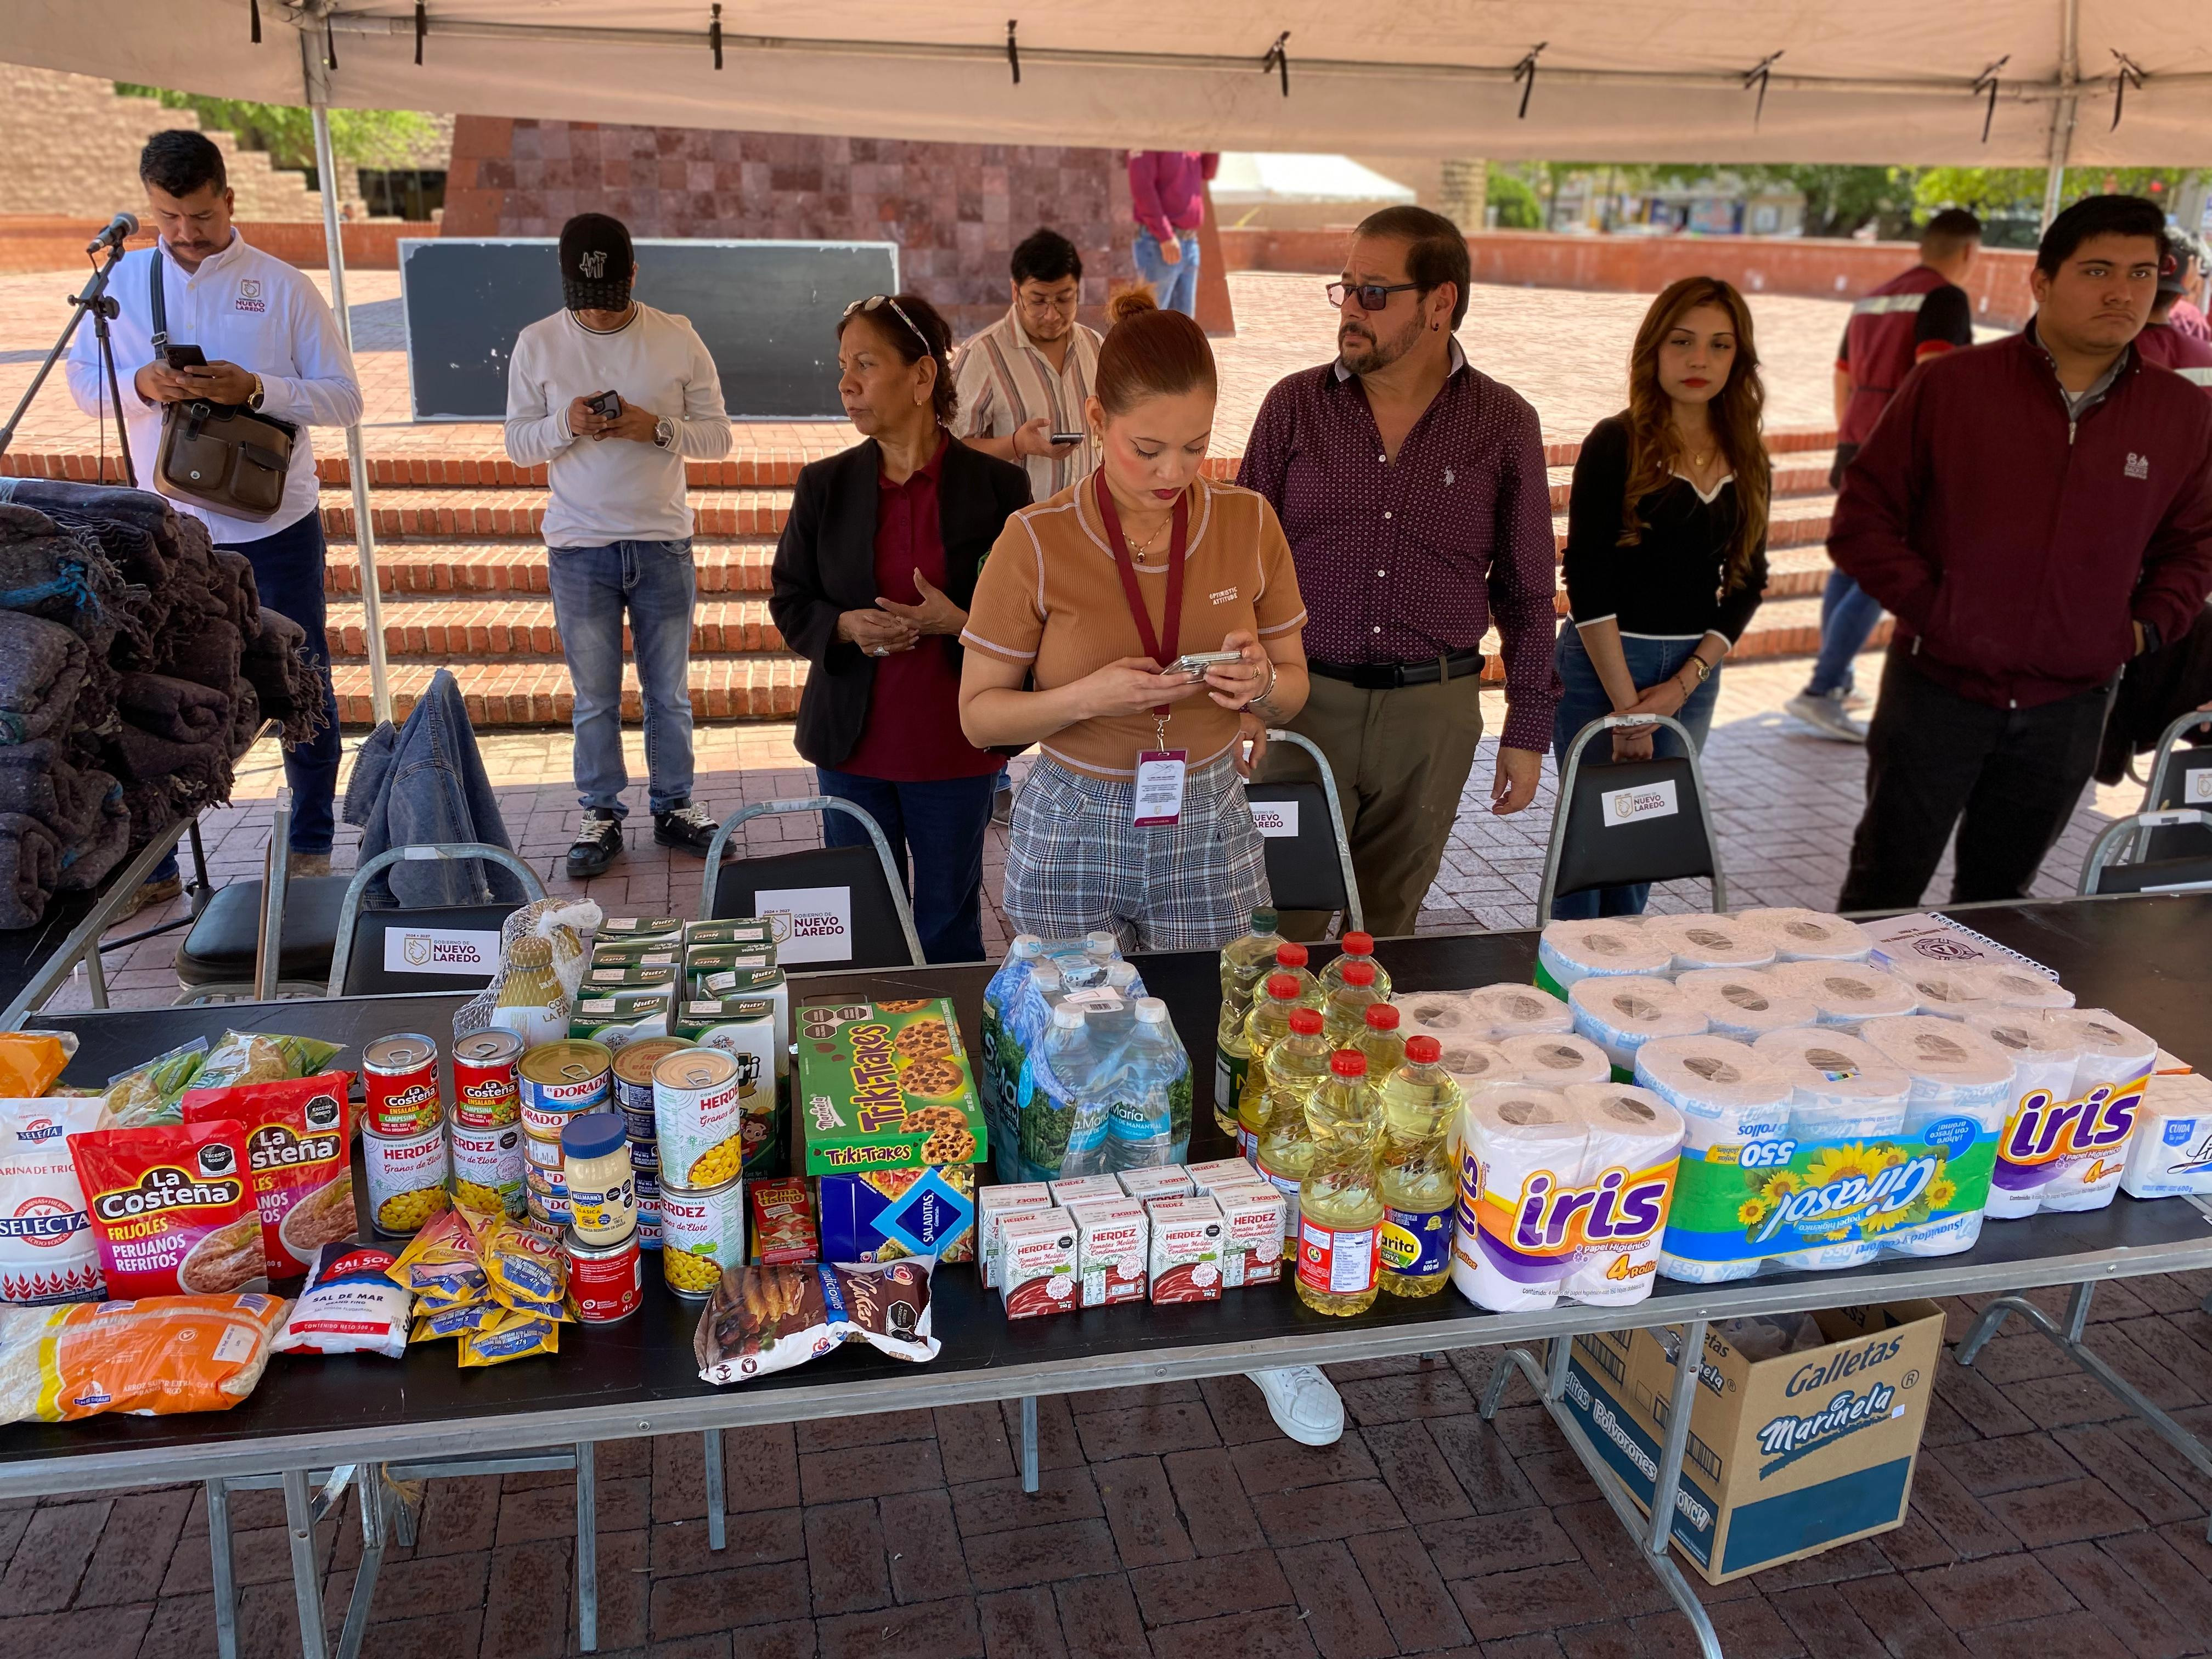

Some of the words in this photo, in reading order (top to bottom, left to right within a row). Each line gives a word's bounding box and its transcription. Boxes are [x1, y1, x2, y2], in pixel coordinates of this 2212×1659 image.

[1209, 586, 1238, 599] OPTIMISTIC
[1213, 593, 1238, 605] ATTITUDE
[1634, 795, 1661, 805] NUEVO
[1635, 801, 1664, 812] LAREDO
[794, 917, 839, 927] NUEVO
[794, 926, 844, 937] LAREDO
[434, 945, 476, 953] NUEVO
[434, 953, 481, 963] LAREDO
[641, 969, 667, 978] Nutri
[751, 969, 776, 980] Nutri
[634, 998, 660, 1008] Nutri
[739, 1001, 766, 1009] Nutri
[850, 1025, 907, 1132] Triki-Trakes
[409, 1086, 420, 1096] La
[467, 1084, 515, 1098] Costeña
[486, 1082, 496, 1091] La
[554, 1073, 610, 1098] DORADO
[389, 1086, 435, 1107] Costeña
[700, 1084, 738, 1111] HERDE
[390, 1106, 420, 1115] ENSALADA
[464, 1105, 492, 1113] CAMPESINA
[812, 1096, 833, 1129] Marinela
[385, 1114, 416, 1122] CAMPESINA
[521, 1109, 562, 1125] ORADO
[700, 1111, 728, 1127] Granos
[2010, 1088, 2142, 1158] iris
[1737, 1124, 1778, 1138] rollos
[1938, 1121, 1966, 1131] aroma!
[2169, 1124, 2191, 1133] CUIDA
[1930, 1127, 1957, 1138] fresco
[259, 1131, 285, 1147] La
[384, 1137, 440, 1160] HERDEZ
[1741, 1141, 1796, 1167] 550
[2066, 1153, 2087, 1161] Papel
[2089, 1146, 2122, 1158] Higiénico
[477, 1156, 497, 1164] Elote
[826, 1146, 910, 1165] Triki-Trakes
[0, 1167, 33, 1176] ARINA
[34, 1166, 48, 1175] DE
[384, 1163, 414, 1174] Granos
[416, 1160, 426, 1170] de
[1191, 1164, 1220, 1172] HERDEZ
[2083, 1159, 2105, 1184] 4
[152, 1172, 180, 1188] La
[573, 1193, 602, 1201] HELLMANN'S
[757, 1189, 797, 1198] Toma
[1251, 1194, 1281, 1202] HERDEZ
[1756, 1156, 1937, 1243] Girasol
[103, 1183, 229, 1217] Costeña
[1516, 1172, 1667, 1247] iris
[0, 1211, 90, 1235] SELECTA
[923, 1194, 934, 1243] SALADITAS
[1003, 1215, 1036, 1224] HERDEZ
[1234, 1213, 1276, 1226] HERDEZ
[1837, 1215, 1862, 1229] Papel
[107, 1217, 168, 1241] FRIJOLES
[677, 1222, 686, 1231] de
[687, 1223, 708, 1232] Elote
[1230, 1225, 1254, 1234] Tomates
[1799, 1221, 1835, 1233] higiénico
[1092, 1228, 1136, 1242] HERDEZ
[1166, 1230, 1203, 1240] HERDEZ
[1232, 1229, 1276, 1239] Condimentados
[111, 1233, 187, 1259] PERUANOS
[1116, 1238, 1139, 1247] Molidos
[1166, 1242, 1189, 1250] Tomates
[1584, 1243, 1609, 1254] Papel
[1610, 1240, 1650, 1252] Higiénico
[1018, 1243, 1055, 1255] HERDEZ
[1091, 1244, 1137, 1256] Condimentados
[1168, 1246, 1211, 1255] Condimentados
[1824, 1244, 1853, 1261] 550
[115, 1252, 178, 1272] REFRITOS
[1018, 1256, 1042, 1265] Tomates
[1382, 1251, 1400, 1262] SOYA
[334, 1257, 359, 1273] SAL
[363, 1256, 391, 1265] SOL
[1021, 1259, 1064, 1269] Condimentados
[1433, 1262, 1439, 1270] ml
[1607, 1254, 1630, 1280] 4
[1669, 1261, 1703, 1277] 550
[357, 1293, 384, 1302] MAR
[1522, 1288, 1548, 1296] Contenido:
[1785, 1334, 1905, 1398] Galletas
[123, 1382, 146, 1392] ARROZ
[1759, 1386, 1892, 1453] Marinela
[1594, 1399, 1657, 1481] Polvorones
